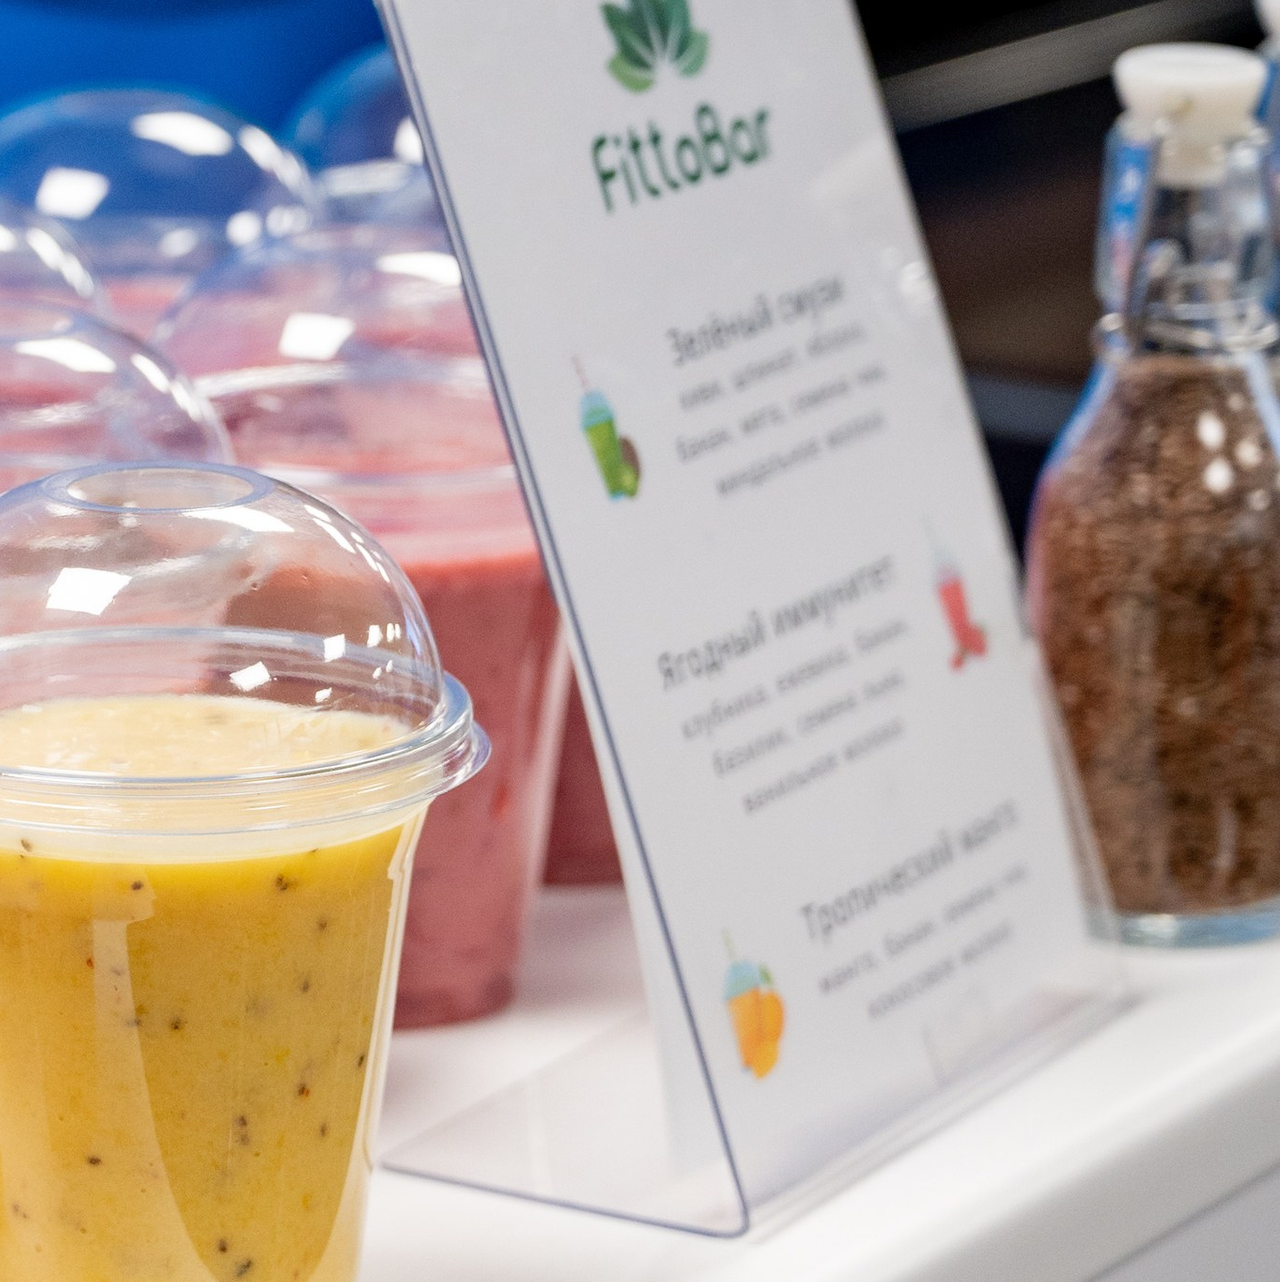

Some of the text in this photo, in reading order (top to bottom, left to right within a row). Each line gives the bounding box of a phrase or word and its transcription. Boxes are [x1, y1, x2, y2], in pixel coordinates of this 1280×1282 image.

[591, 102, 769, 213] FittoBar
[657, 610, 766, 692] Ягодный
[801, 828, 954, 944] Тропический
